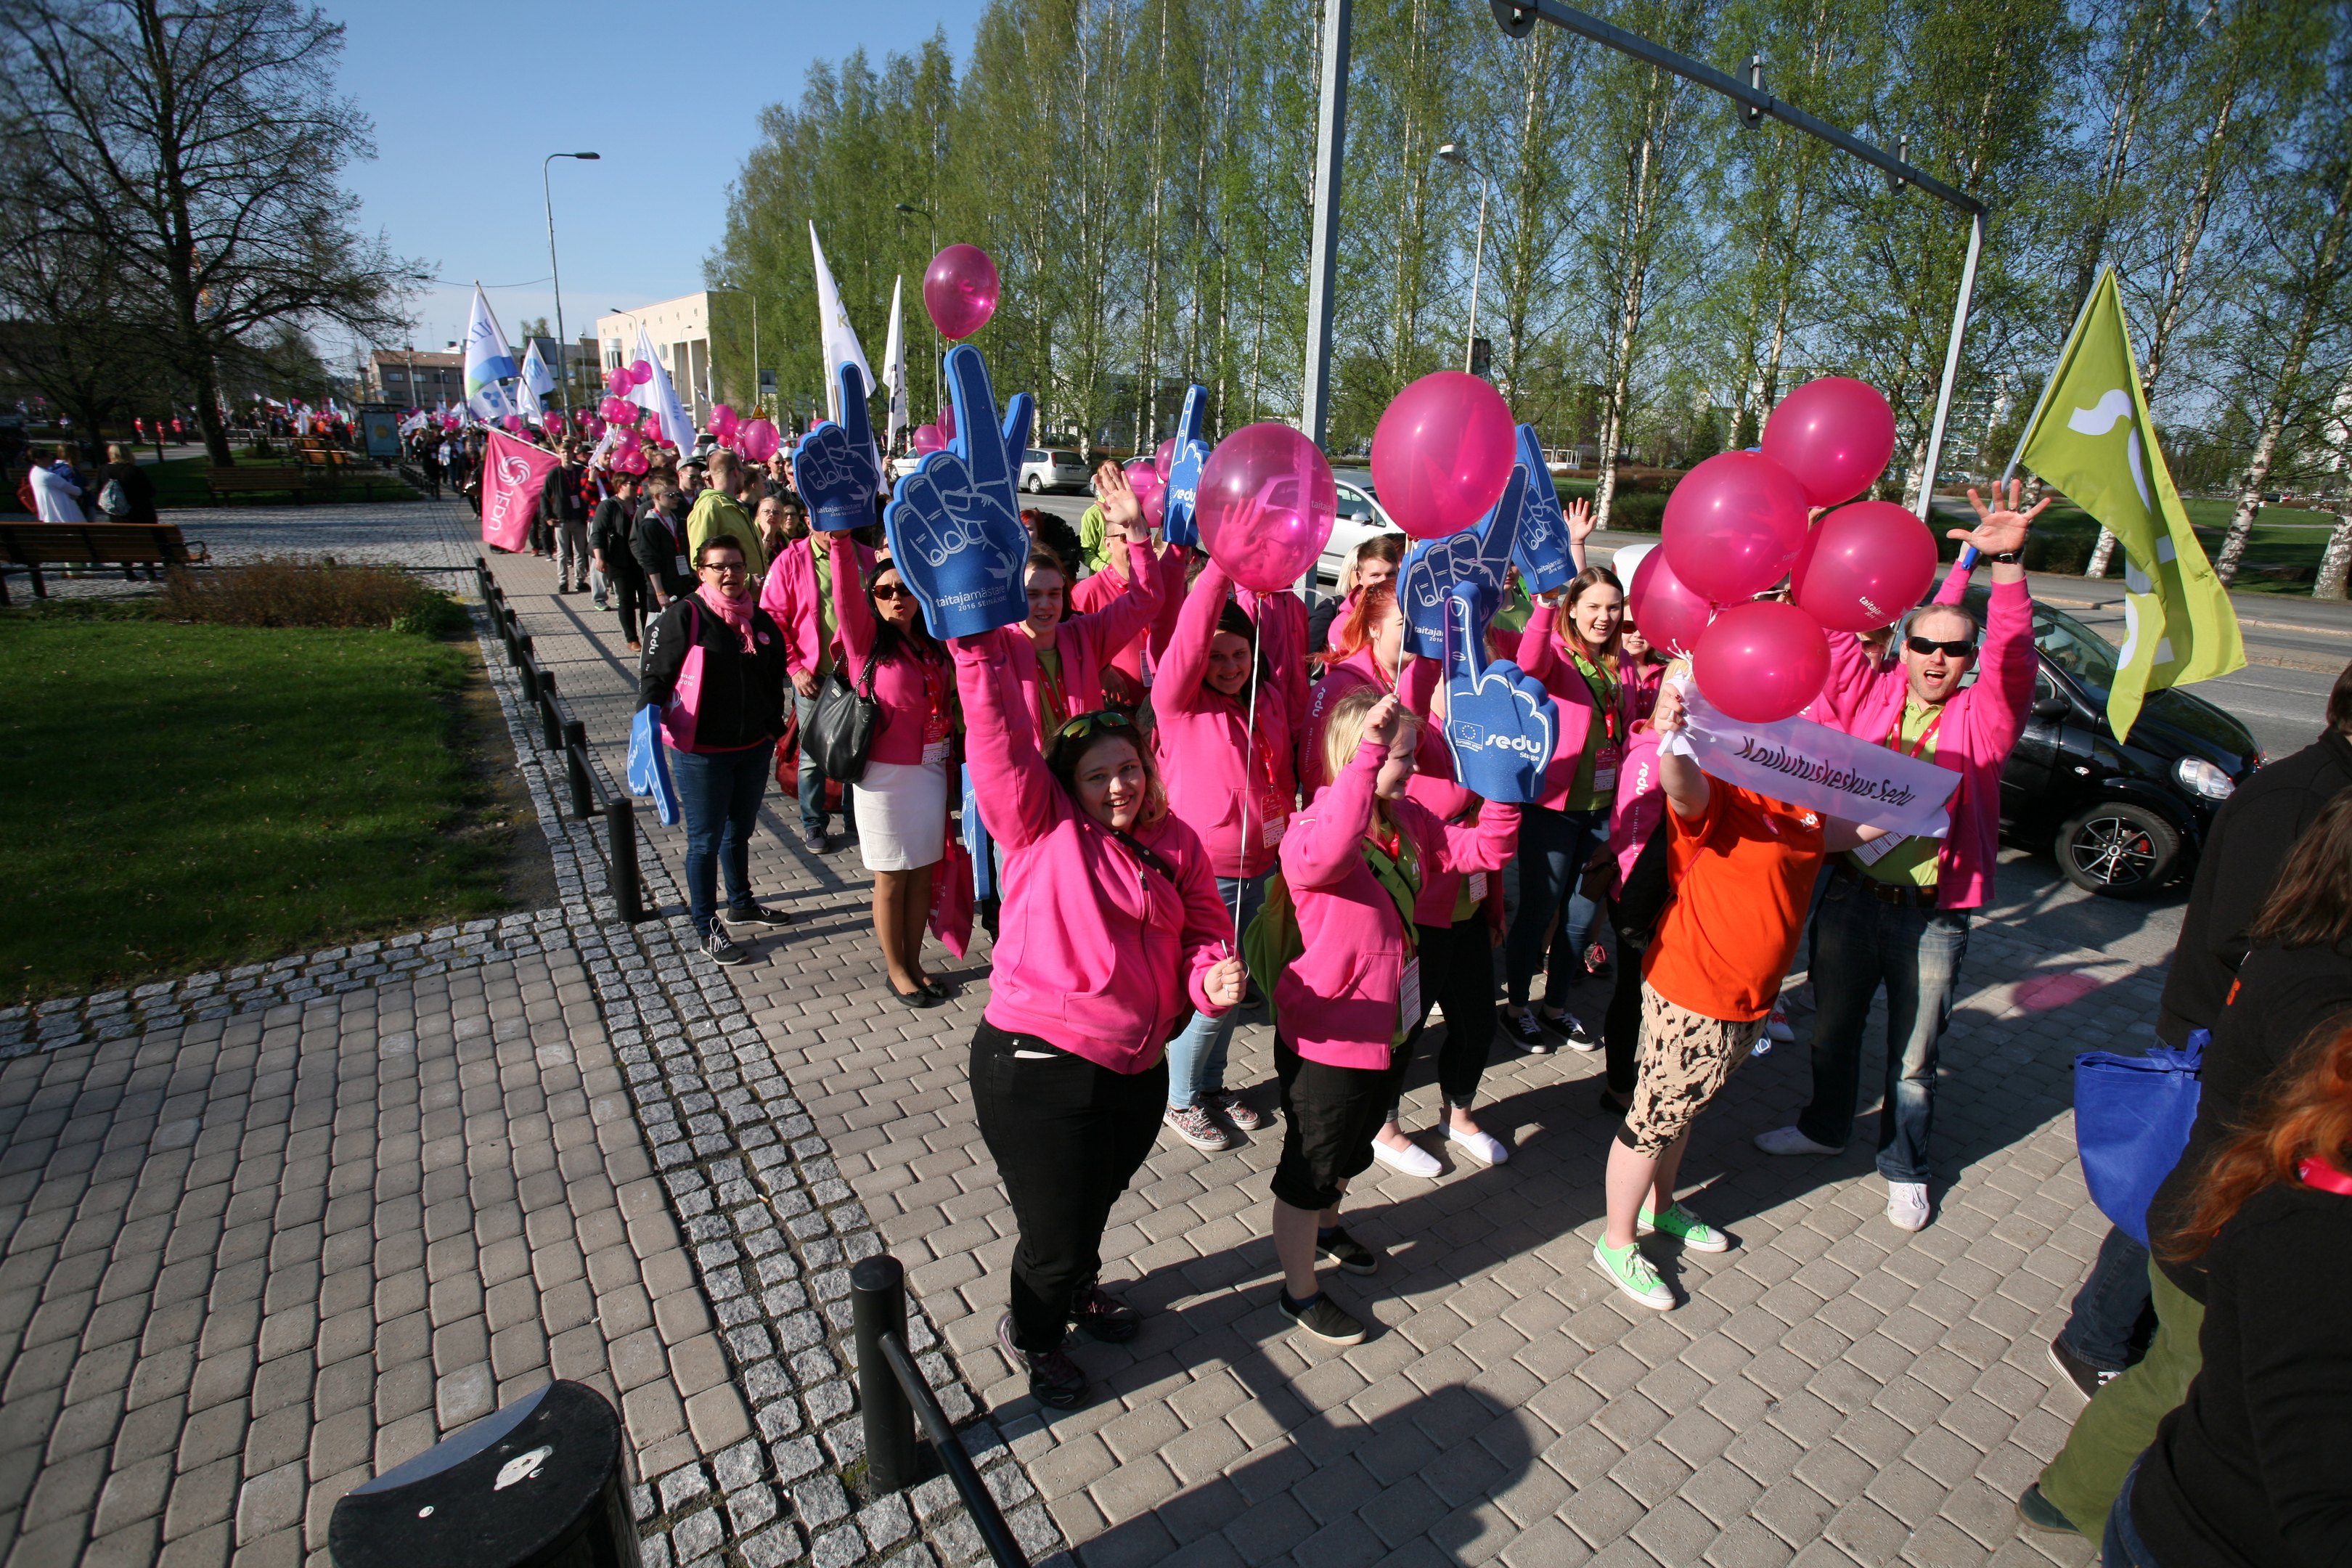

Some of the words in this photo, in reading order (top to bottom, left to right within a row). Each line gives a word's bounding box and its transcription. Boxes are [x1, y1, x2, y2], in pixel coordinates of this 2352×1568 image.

[935, 585, 1006, 608] taitajamästare
[957, 603, 976, 612] 2016
[1312, 687, 1326, 717] sedu
[1485, 734, 1541, 754] sedu
[1636, 762, 1649, 796] sedu
[1734, 735, 1877, 796] Koulutuskeskus
[1871, 779, 1916, 807] Sedu
